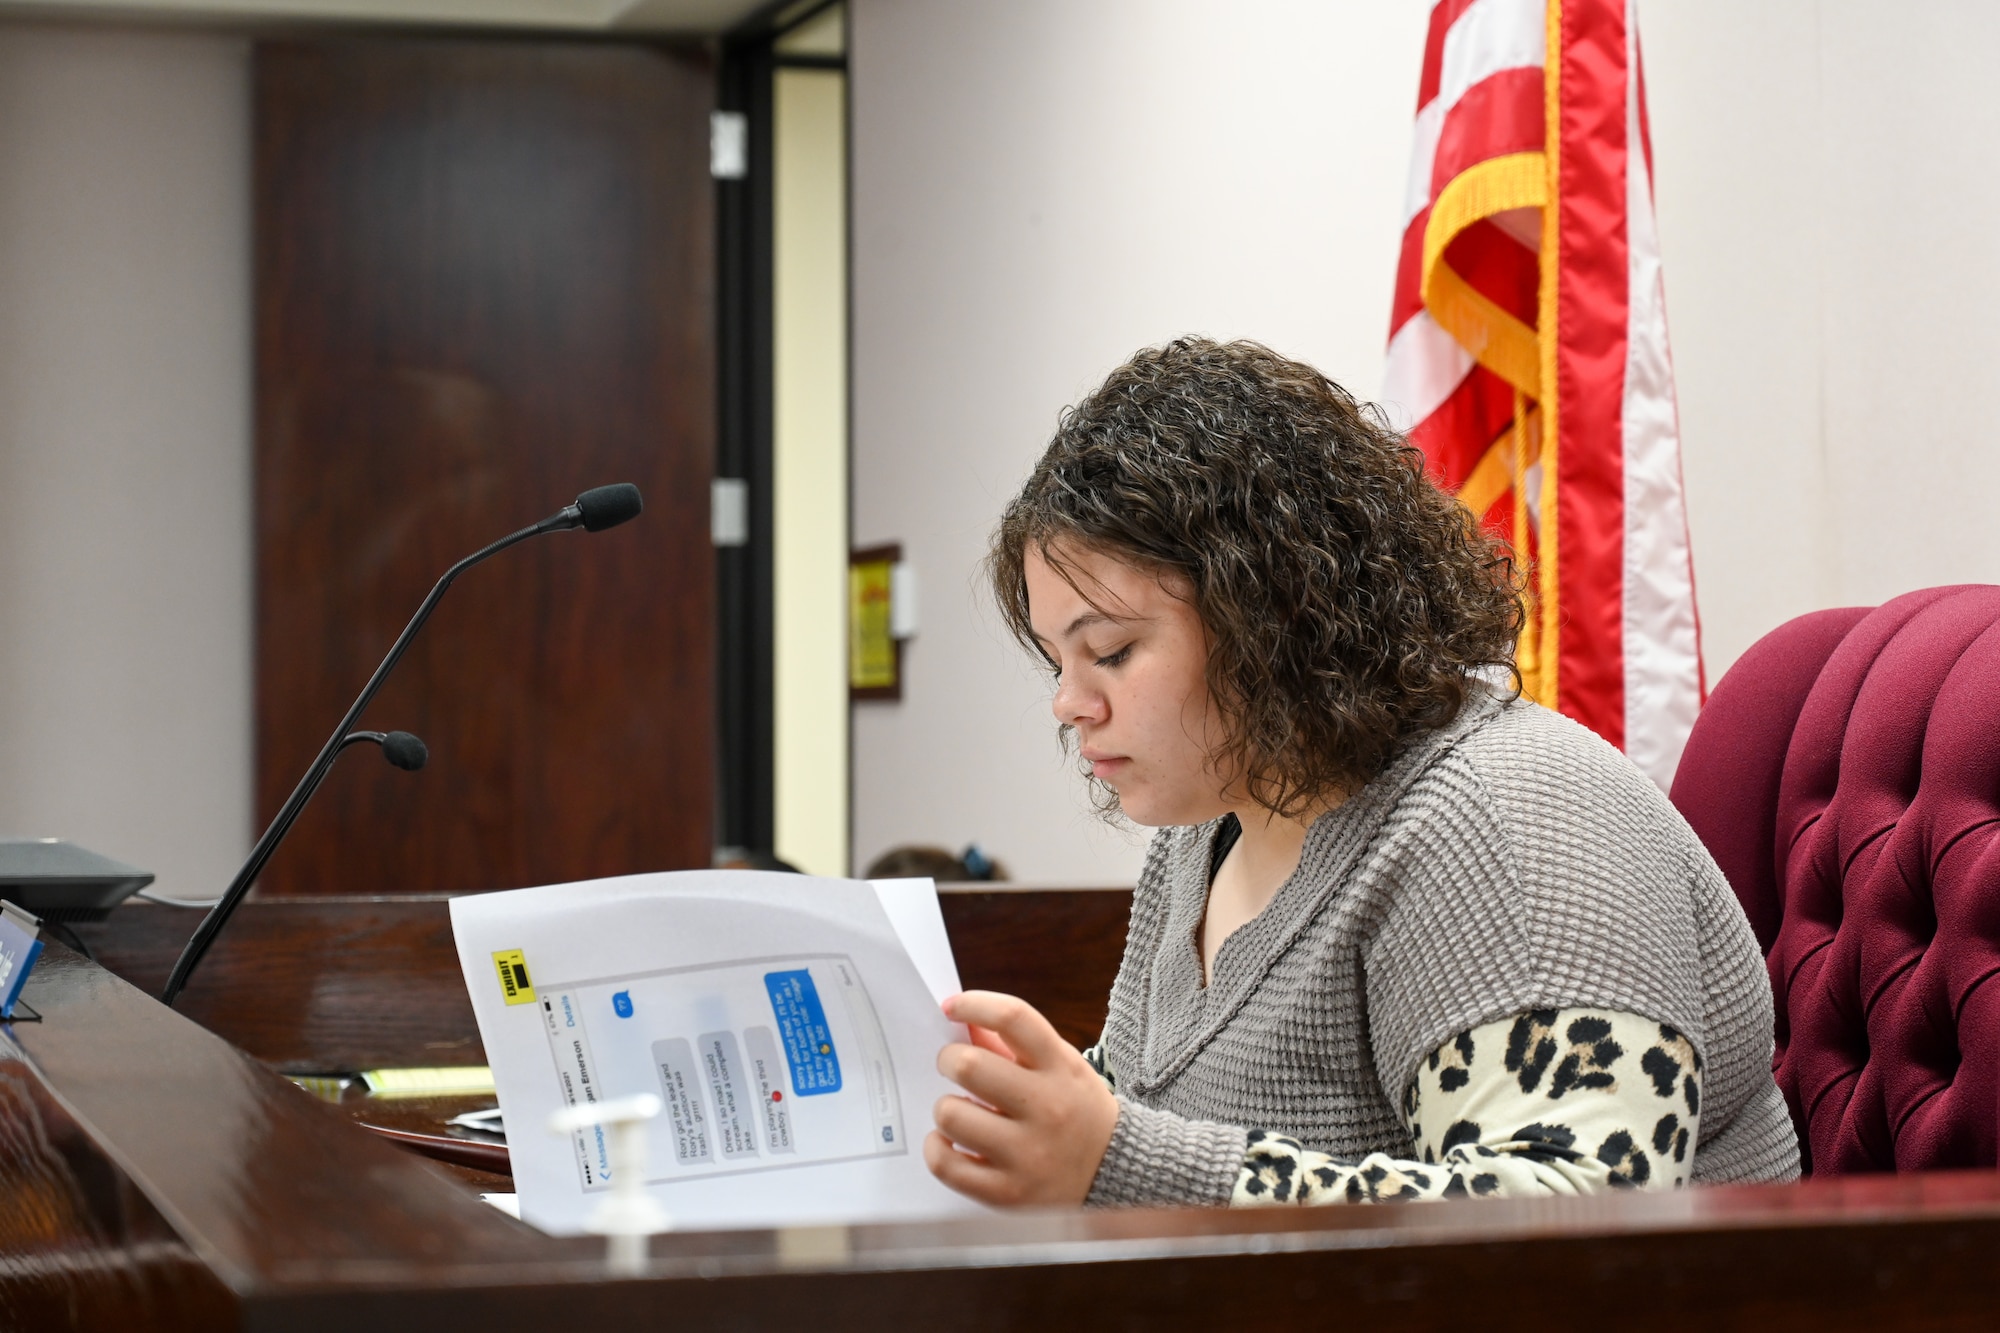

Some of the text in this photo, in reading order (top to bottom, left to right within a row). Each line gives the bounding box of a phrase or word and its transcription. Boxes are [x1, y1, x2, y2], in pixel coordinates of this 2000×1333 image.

[498, 959, 517, 997] EXHIBIT
[790, 977, 803, 1003] Stage
[774, 993, 784, 1005] be
[783, 987, 792, 998] as
[560, 995, 576, 1028] Details
[787, 1000, 798, 1016] you
[791, 1017, 800, 1027] of
[814, 1024, 825, 1041] lolz
[788, 1038, 800, 1064] about
[795, 1029, 806, 1049] both
[804, 1026, 818, 1054] dream
[572, 1040, 589, 1085] Emerson
[706, 1054, 719, 1079] could
[713, 1040, 730, 1082] complete
[800, 1050, 811, 1063] for
[812, 1056, 823, 1070] my
[795, 1066, 807, 1090] sorry
[804, 1064, 816, 1089] there
[816, 1072, 826, 1088] got
[714, 1085, 725, 1106] mad
[725, 1091, 737, 1113] what
[755, 1059, 778, 1148] I'm playing the third
[661, 1063, 688, 1159] Rory got the lead and
[674, 1071, 698, 1158] Rory's audition was
[720, 1107, 728, 1118] so
[592, 1121, 608, 1170] Message
